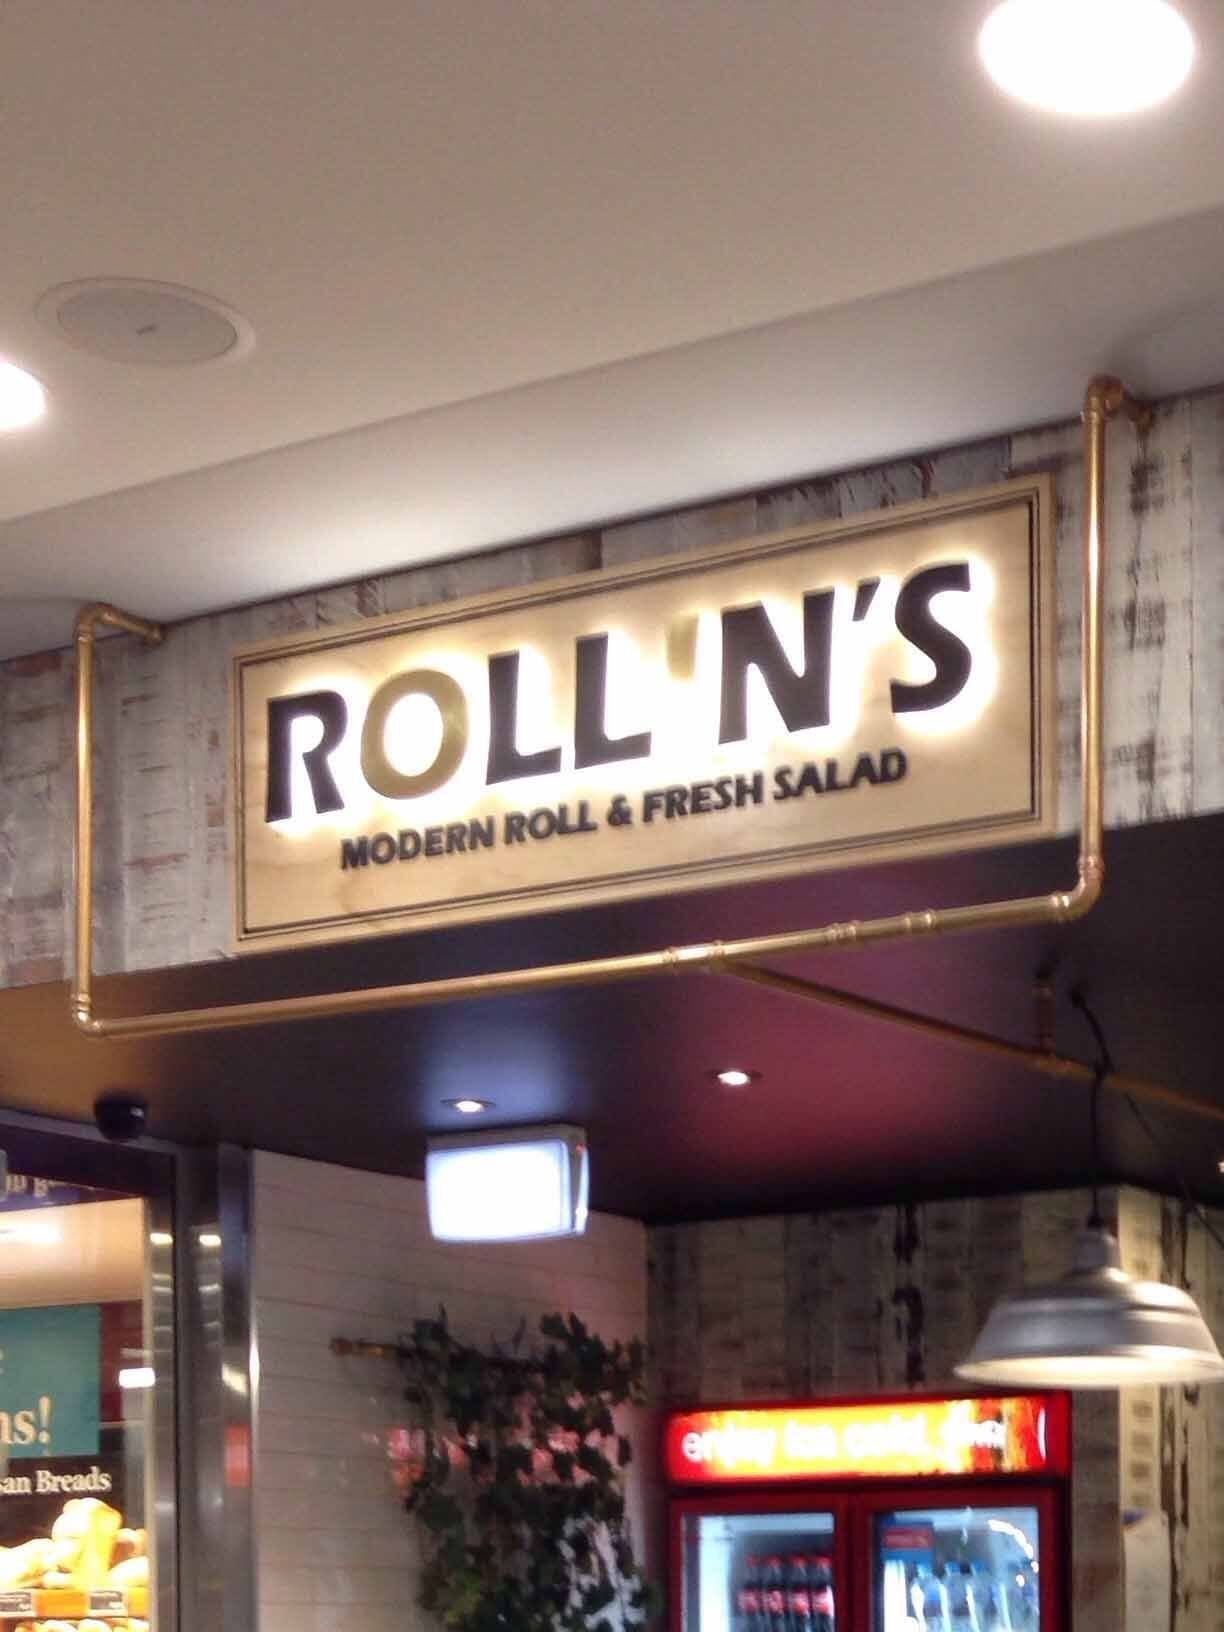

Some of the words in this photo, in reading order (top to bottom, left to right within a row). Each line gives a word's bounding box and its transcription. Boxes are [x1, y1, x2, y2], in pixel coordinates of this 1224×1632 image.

[340, 816, 496, 871] MODERN
[503, 801, 598, 847] ROLL
[606, 794, 632, 828] &
[642, 771, 764, 824] FRESH
[773, 747, 909, 801] SALAD
[35, 1465, 113, 1493] Breads
